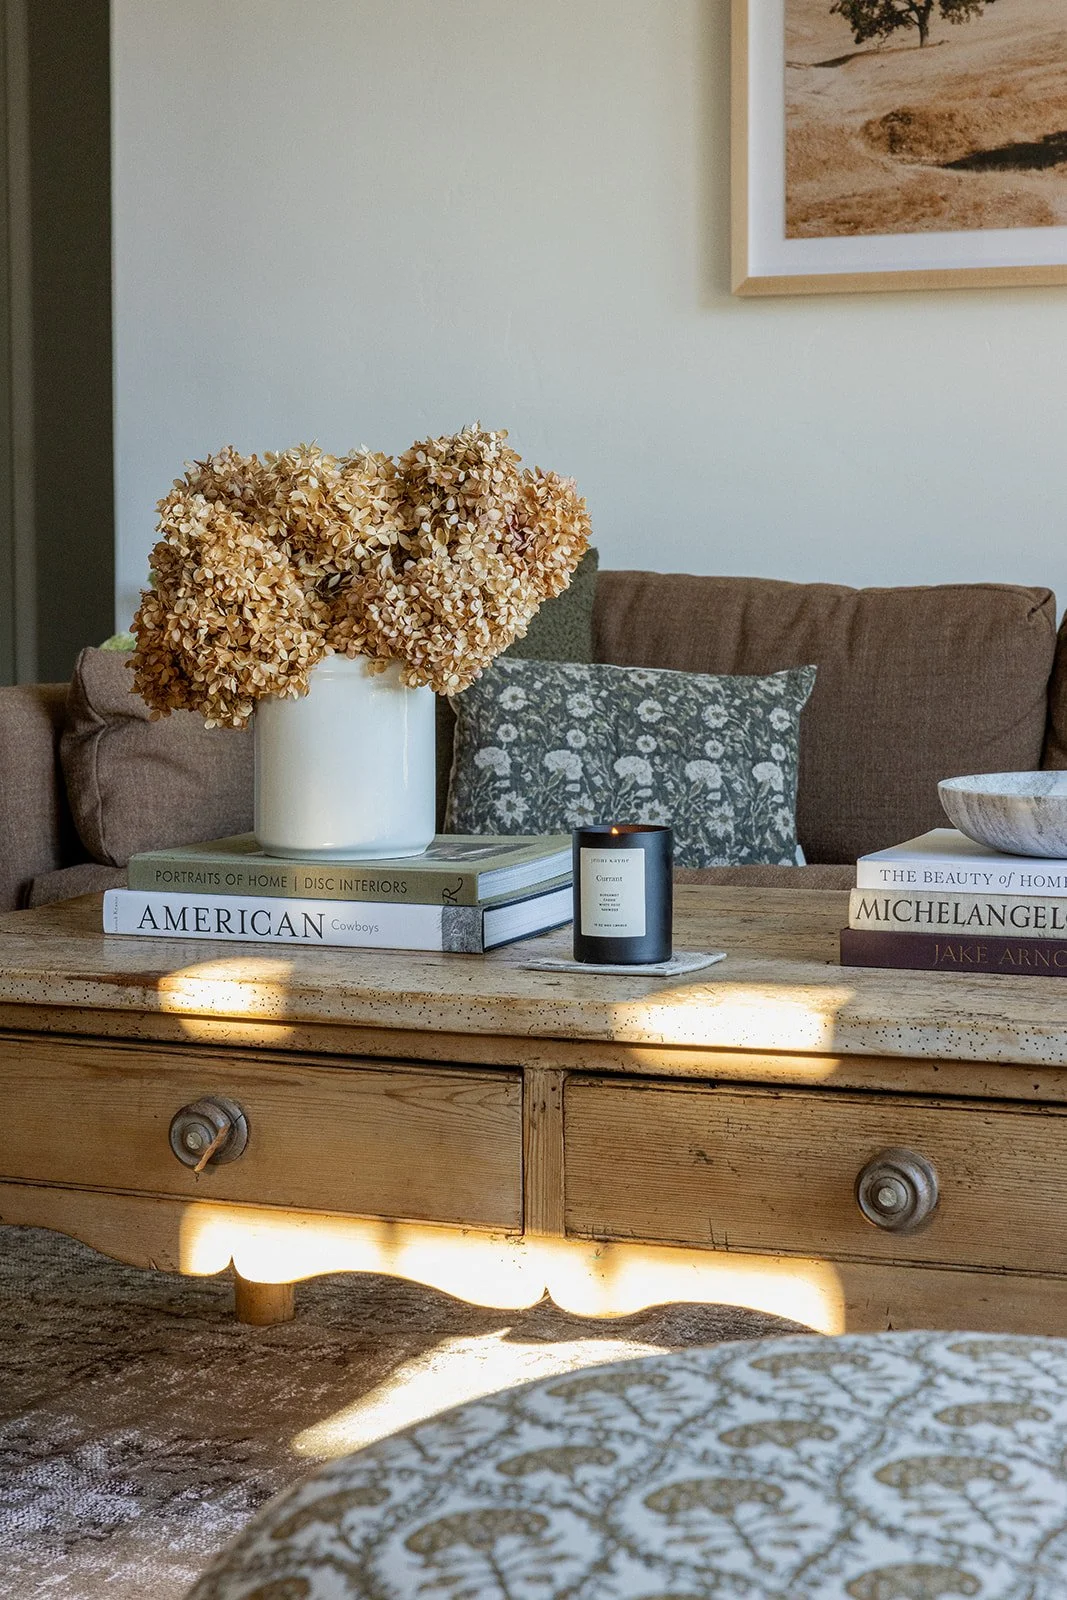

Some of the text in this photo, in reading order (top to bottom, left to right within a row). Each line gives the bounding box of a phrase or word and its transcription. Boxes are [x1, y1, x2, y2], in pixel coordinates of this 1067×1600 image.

[156, 870, 408, 894] PORTRAITS OF HOME DISC INTERIORS
[595, 874, 623, 882] Currant
[879, 869, 917, 883] THE
[923, 871, 993, 886] BEAUTY
[998, 872, 1016, 888] of
[137, 904, 325, 939] AMERICAN
[331, 919, 379, 935] Cowboys
[856, 898, 1067, 930] MICHELANGEL
[933, 944, 988, 966] JAKE
